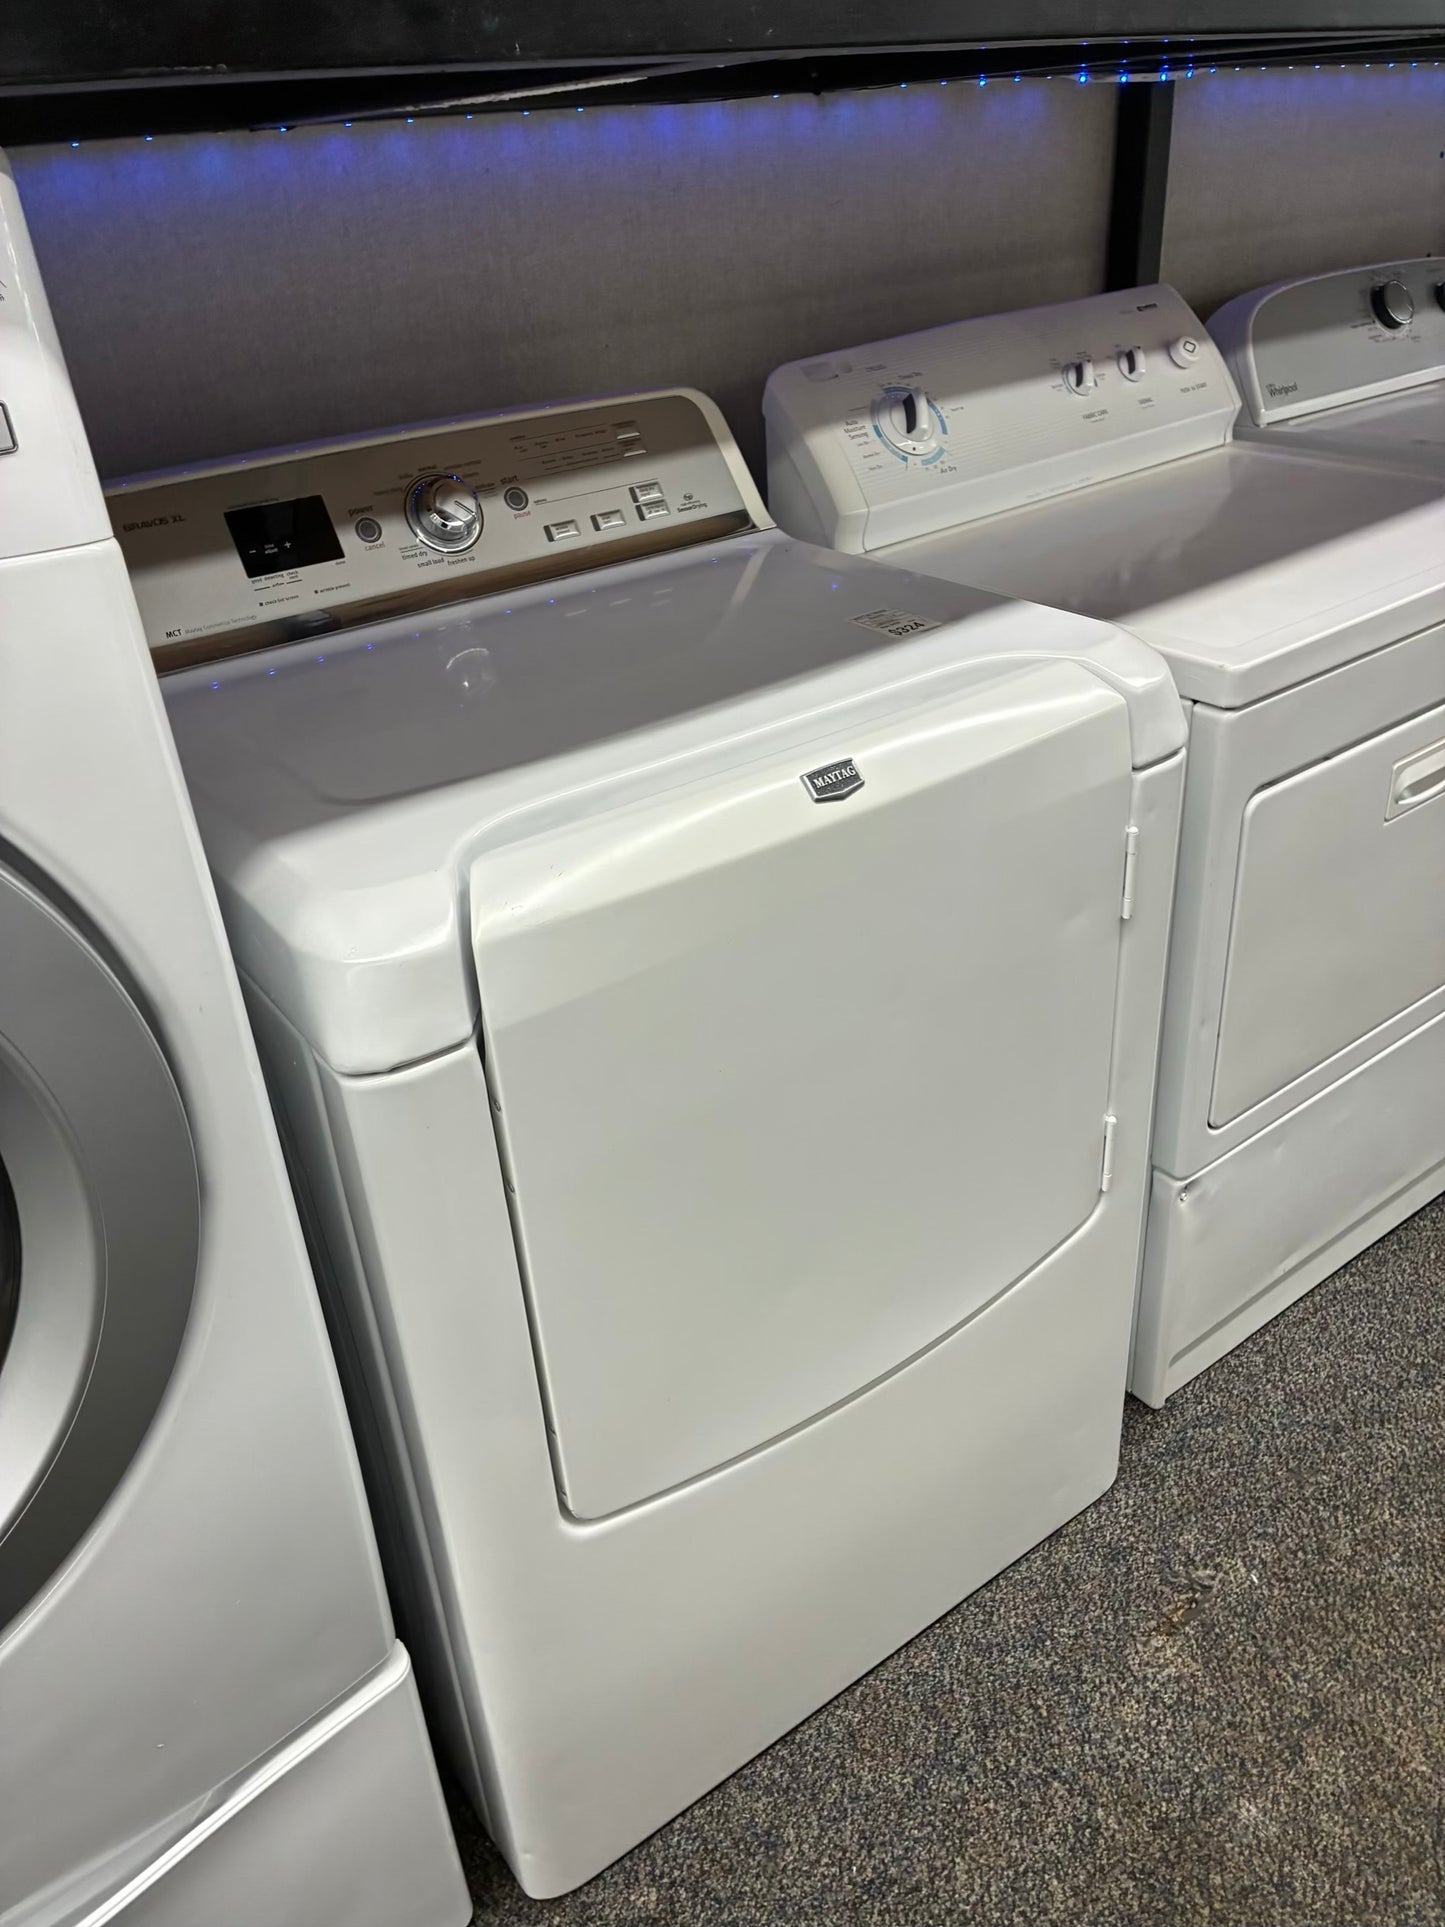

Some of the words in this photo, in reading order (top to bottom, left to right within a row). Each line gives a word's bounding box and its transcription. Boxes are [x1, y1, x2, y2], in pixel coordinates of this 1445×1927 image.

[500, 475, 518, 485] start
[348, 505, 373, 518] power
[123, 516, 169, 532] BRAVOS
[172, 514, 186, 524] XL
[364, 541, 386, 551] cancel
[402, 552, 418, 561] timed
[447, 557, 468, 566] freshen
[417, 560, 432, 568] small
[432, 557, 445, 565] load
[165, 628, 182, 639] MCT
[812, 765, 856, 789] MAYTAG
